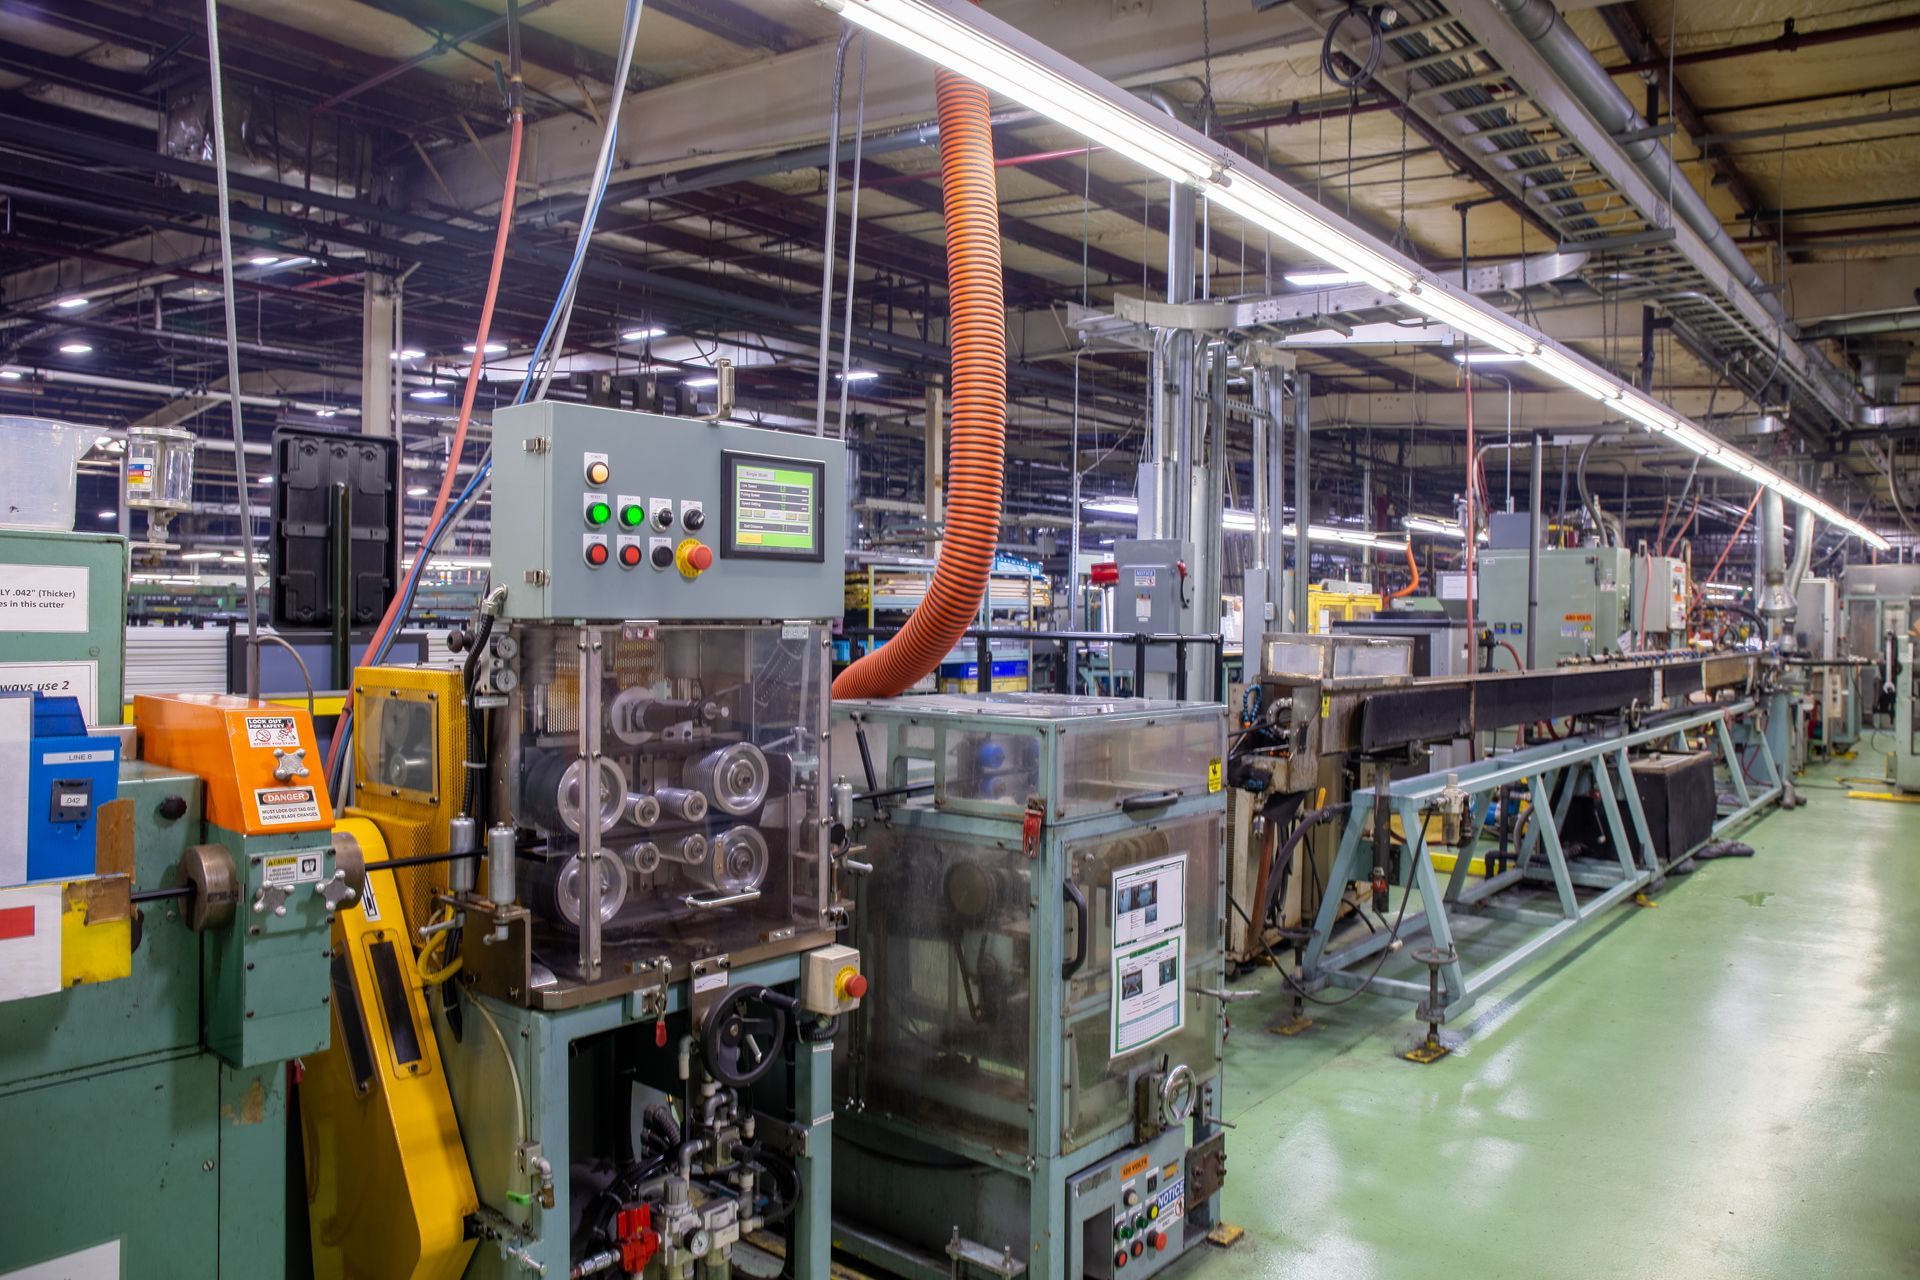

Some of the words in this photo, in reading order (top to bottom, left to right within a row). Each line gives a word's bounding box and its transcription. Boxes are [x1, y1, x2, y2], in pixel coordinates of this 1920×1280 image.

[12, 589, 36, 597] .042"
[38, 589, 76, 599] (Thicker)
[9, 600, 18, 608] in
[37, 682, 58, 691] use
[62, 680, 70, 690] 2
[268, 793, 305, 802] DANGER
[1158, 1182, 1184, 1208] NOTICE
